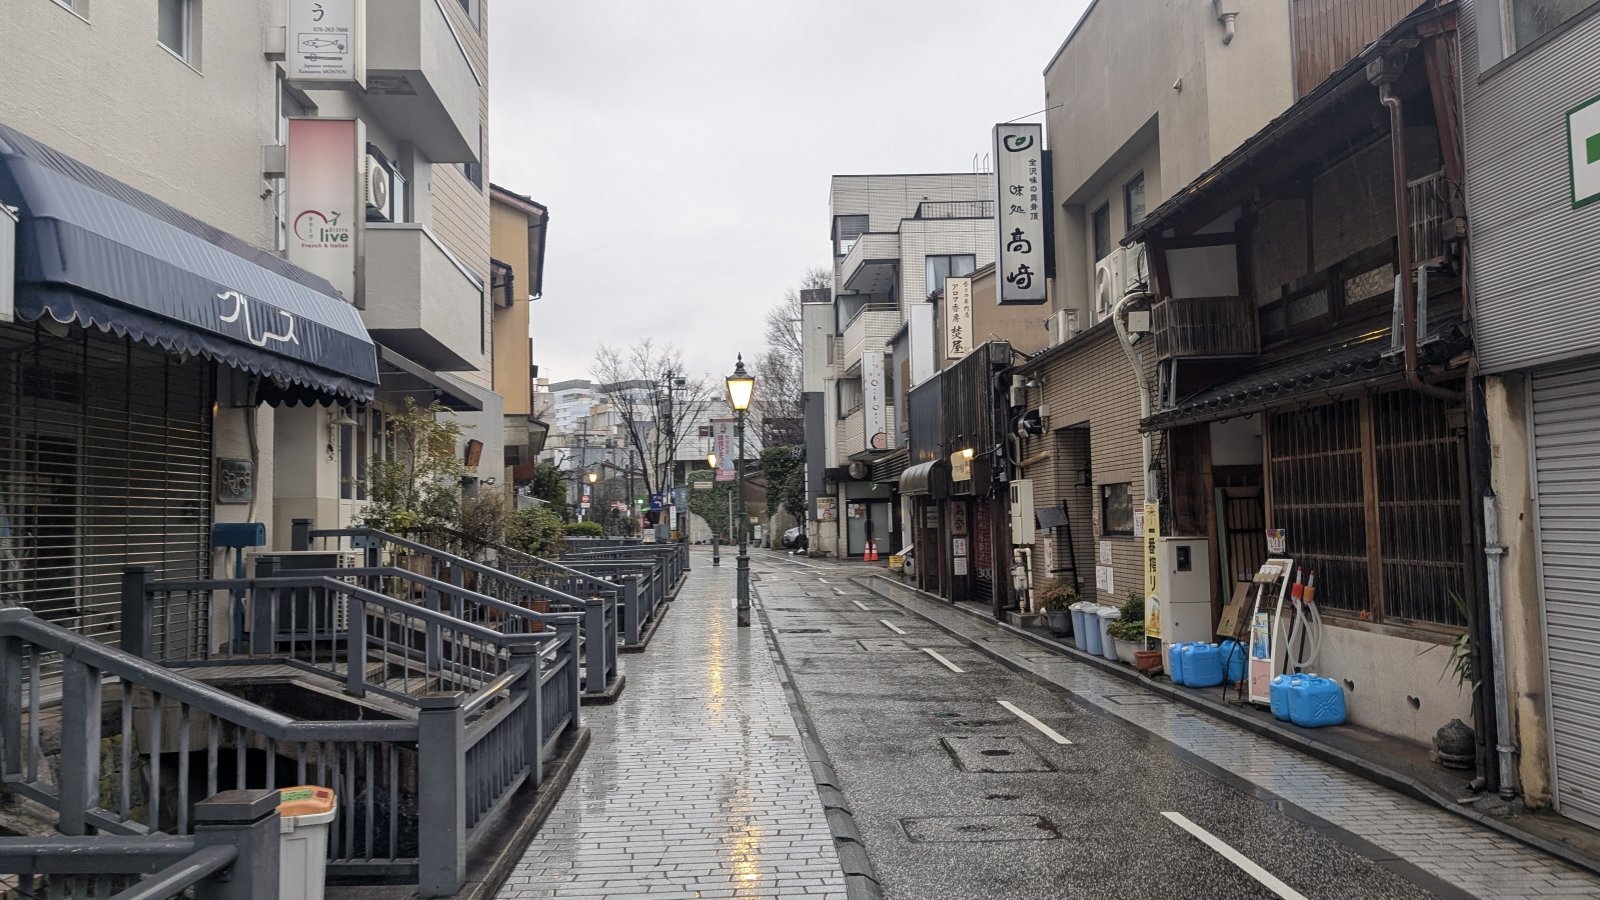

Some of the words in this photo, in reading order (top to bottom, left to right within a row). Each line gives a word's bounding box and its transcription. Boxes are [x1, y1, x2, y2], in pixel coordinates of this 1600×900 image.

[312, 3, 324, 22] う
[1148, 528, 1157, 592] 一番搾り
